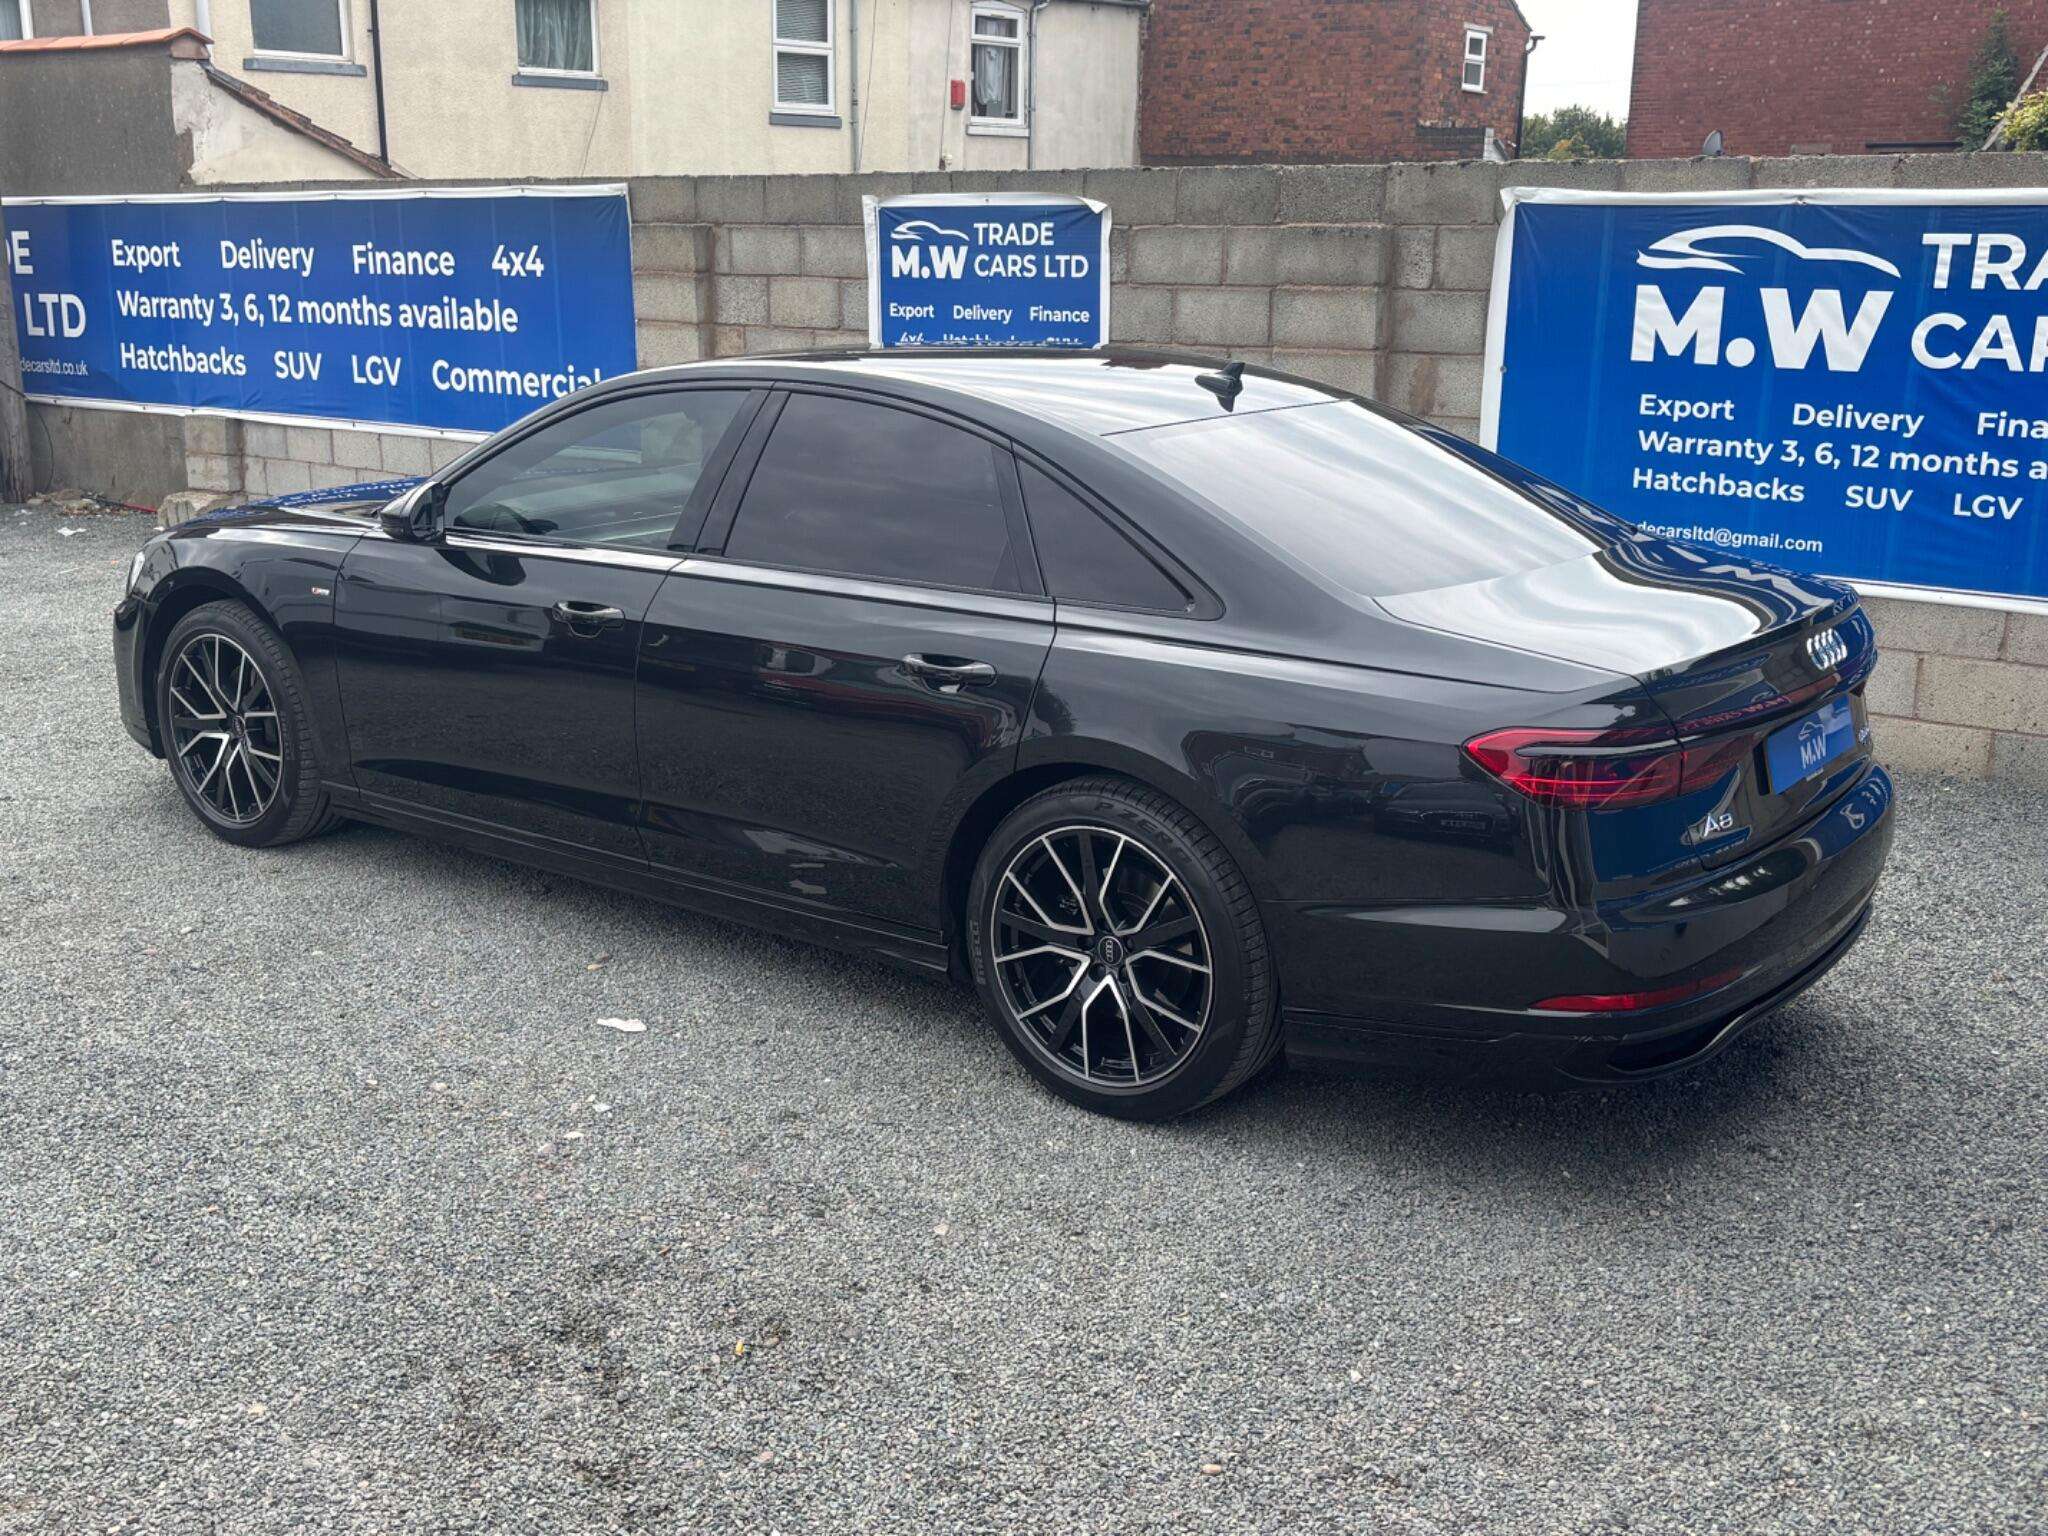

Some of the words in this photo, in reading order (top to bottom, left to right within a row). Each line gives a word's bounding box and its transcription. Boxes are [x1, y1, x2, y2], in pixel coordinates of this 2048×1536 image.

[973, 221, 1054, 246] TRADE
[111, 239, 182, 273] Export
[220, 237, 315, 278] Delivery
[352, 241, 455, 276] Finance
[491, 244, 545, 278] 4x4
[891, 245, 969, 279] M.W
[974, 253, 1037, 278] CARS
[1044, 254, 1089, 278] LTD
[24, 293, 86, 338] LTD
[116, 290, 215, 327] Warranty
[219, 292, 239, 326] 3,
[244, 293, 265, 328] 6,
[268, 293, 292, 323] 12
[297, 294, 392, 327] months
[398, 296, 519, 333] available
[889, 302, 934, 320] Export
[953, 304, 1012, 325] Delivery
[1030, 305, 1090, 323] Finance
[1630, 284, 1894, 372] M.W
[120, 342, 247, 376] Hatchbacks
[273, 350, 322, 381] SUV
[352, 354, 401, 386] LGV
[1640, 394, 1735, 422] Export
[1793, 403, 1925, 438] Delivery
[1638, 430, 1774, 465] Warranty
[1780, 440, 1805, 467] 3,
[1815, 442, 1841, 470] 6,
[1851, 444, 1880, 468] 12
[1889, 451, 2019, 478] months
[1633, 464, 1804, 502] Hatchbacks
[1845, 485, 1913, 511] SUV
[1954, 493, 2023, 520] LGV
[1800, 735, 1827, 770] M.W
[1704, 812, 1734, 837] A8
